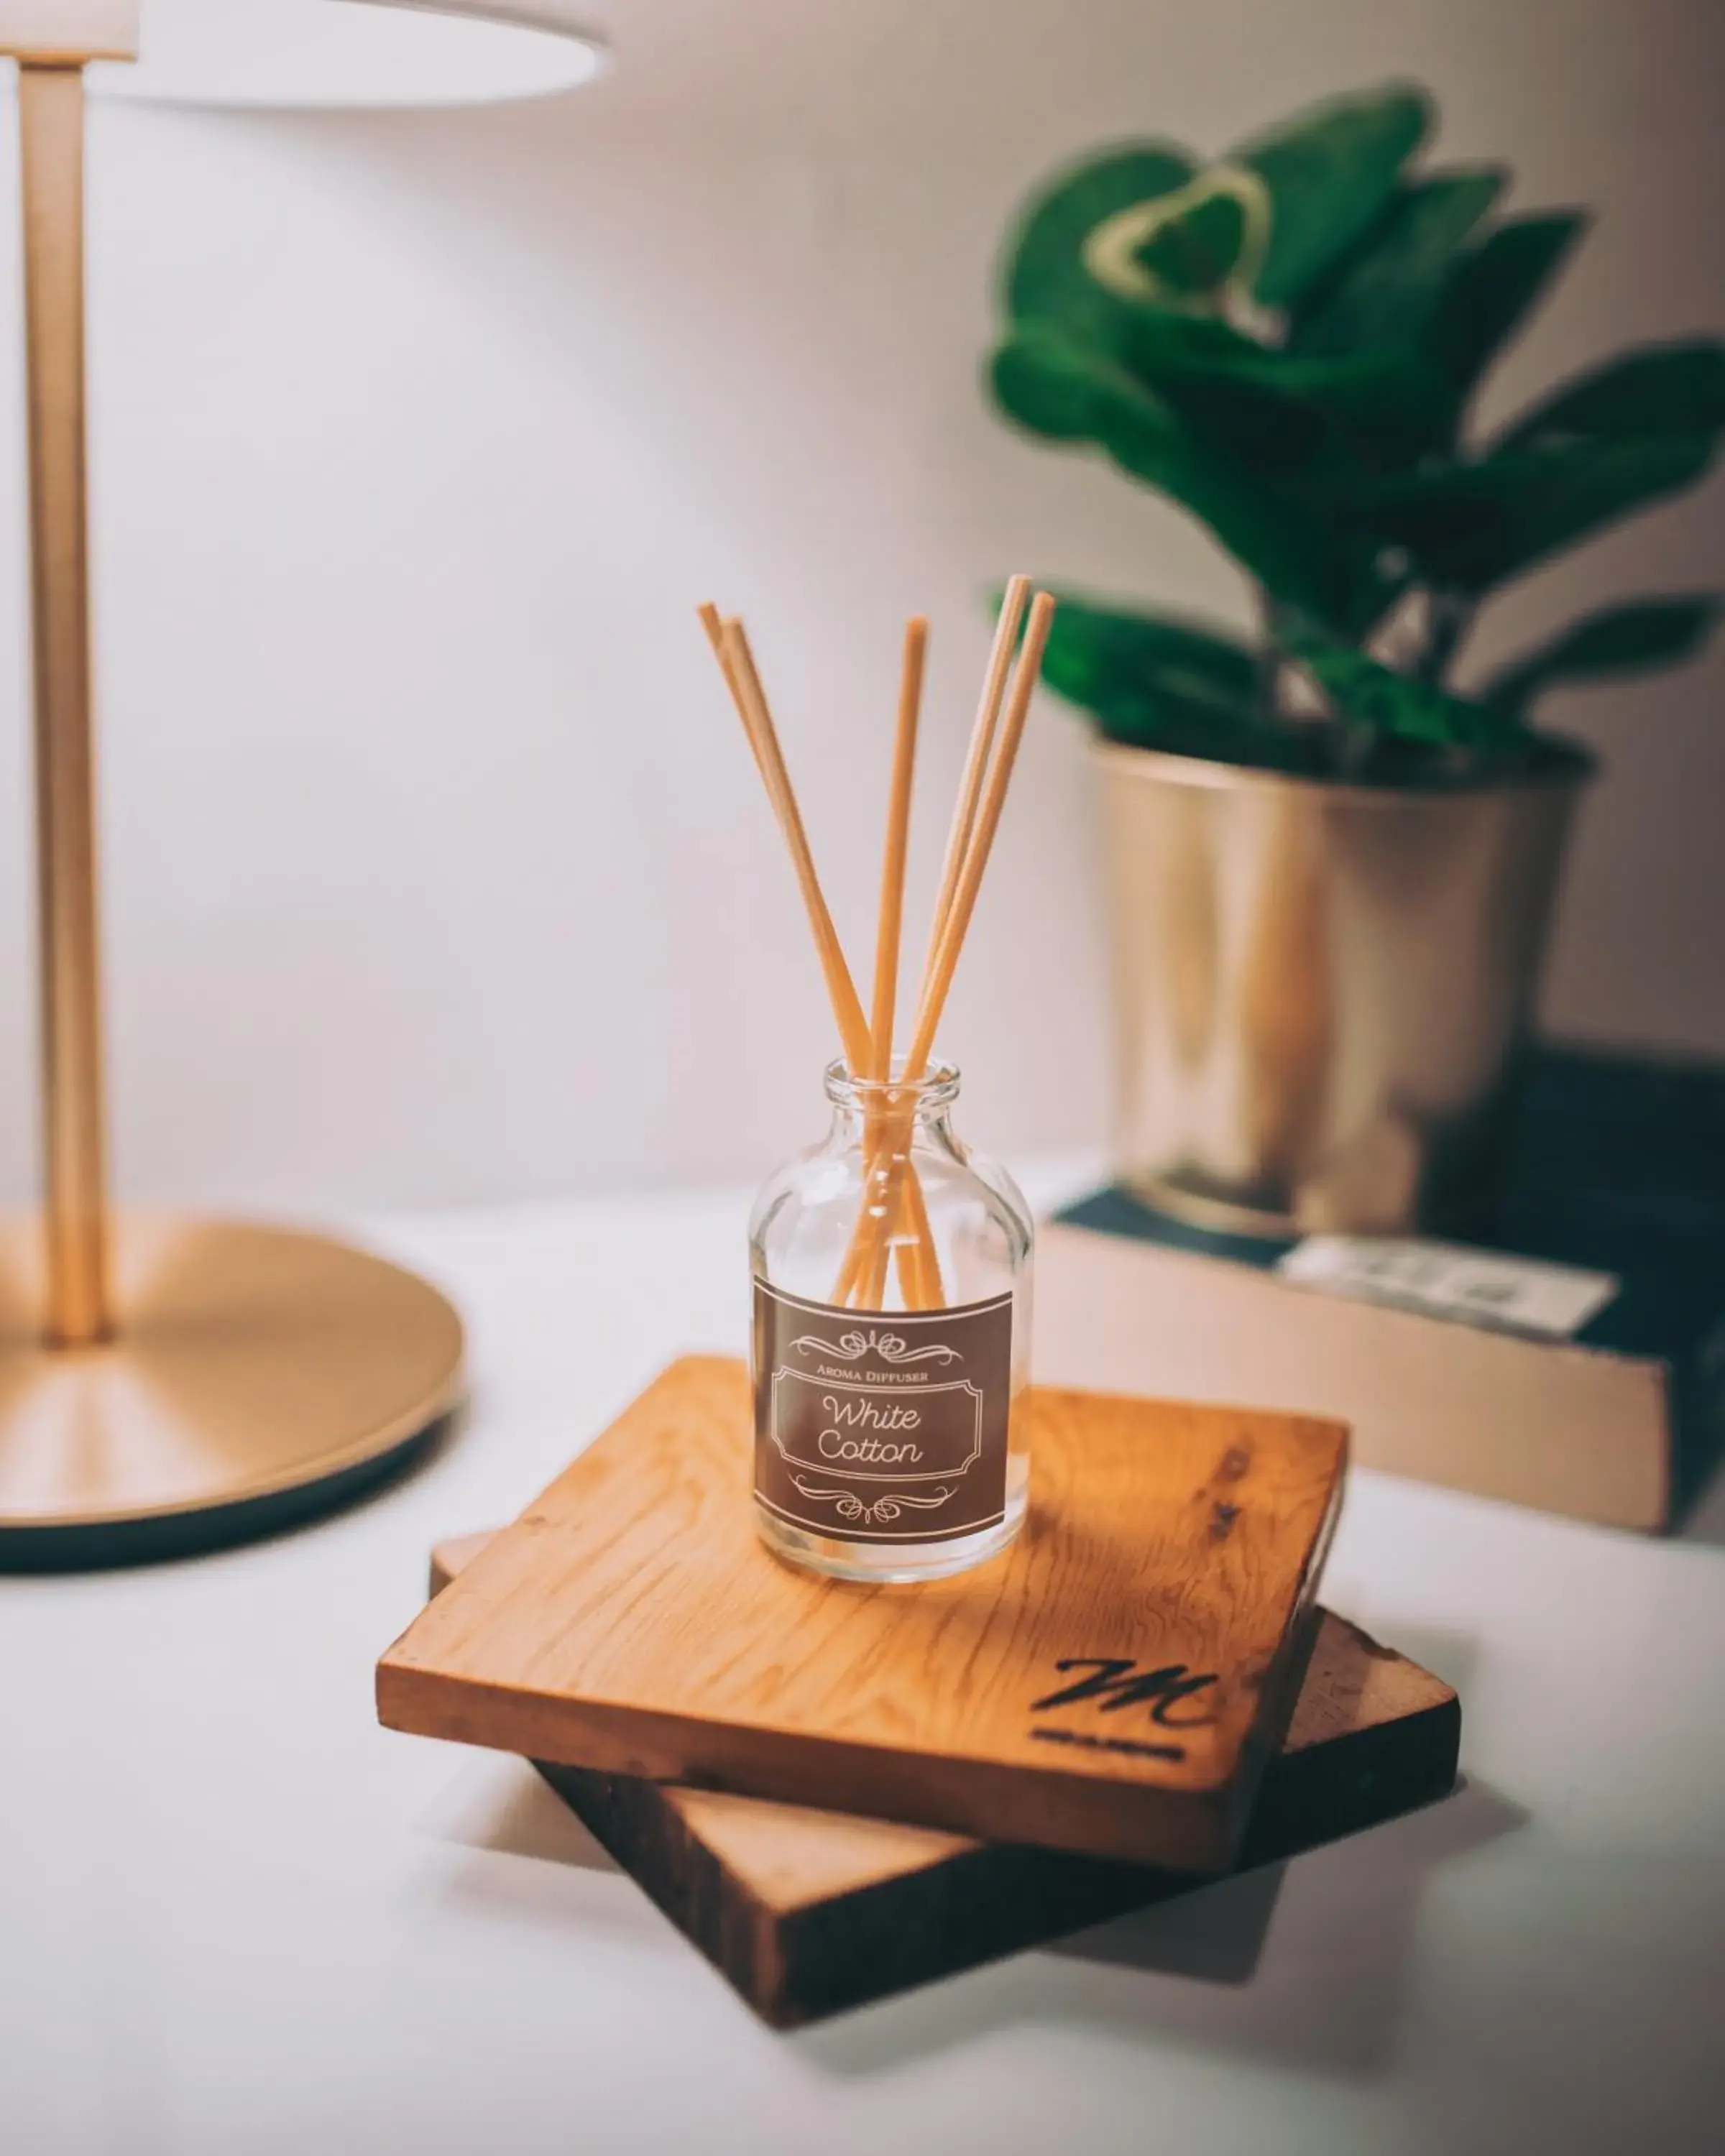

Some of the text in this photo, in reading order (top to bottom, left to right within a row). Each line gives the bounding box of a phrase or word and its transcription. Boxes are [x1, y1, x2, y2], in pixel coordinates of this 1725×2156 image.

[816, 1364, 929, 1383] AROMA DIFFUSER
[822, 1396, 921, 1429] White
[818, 1429, 924, 1462] Cotton
